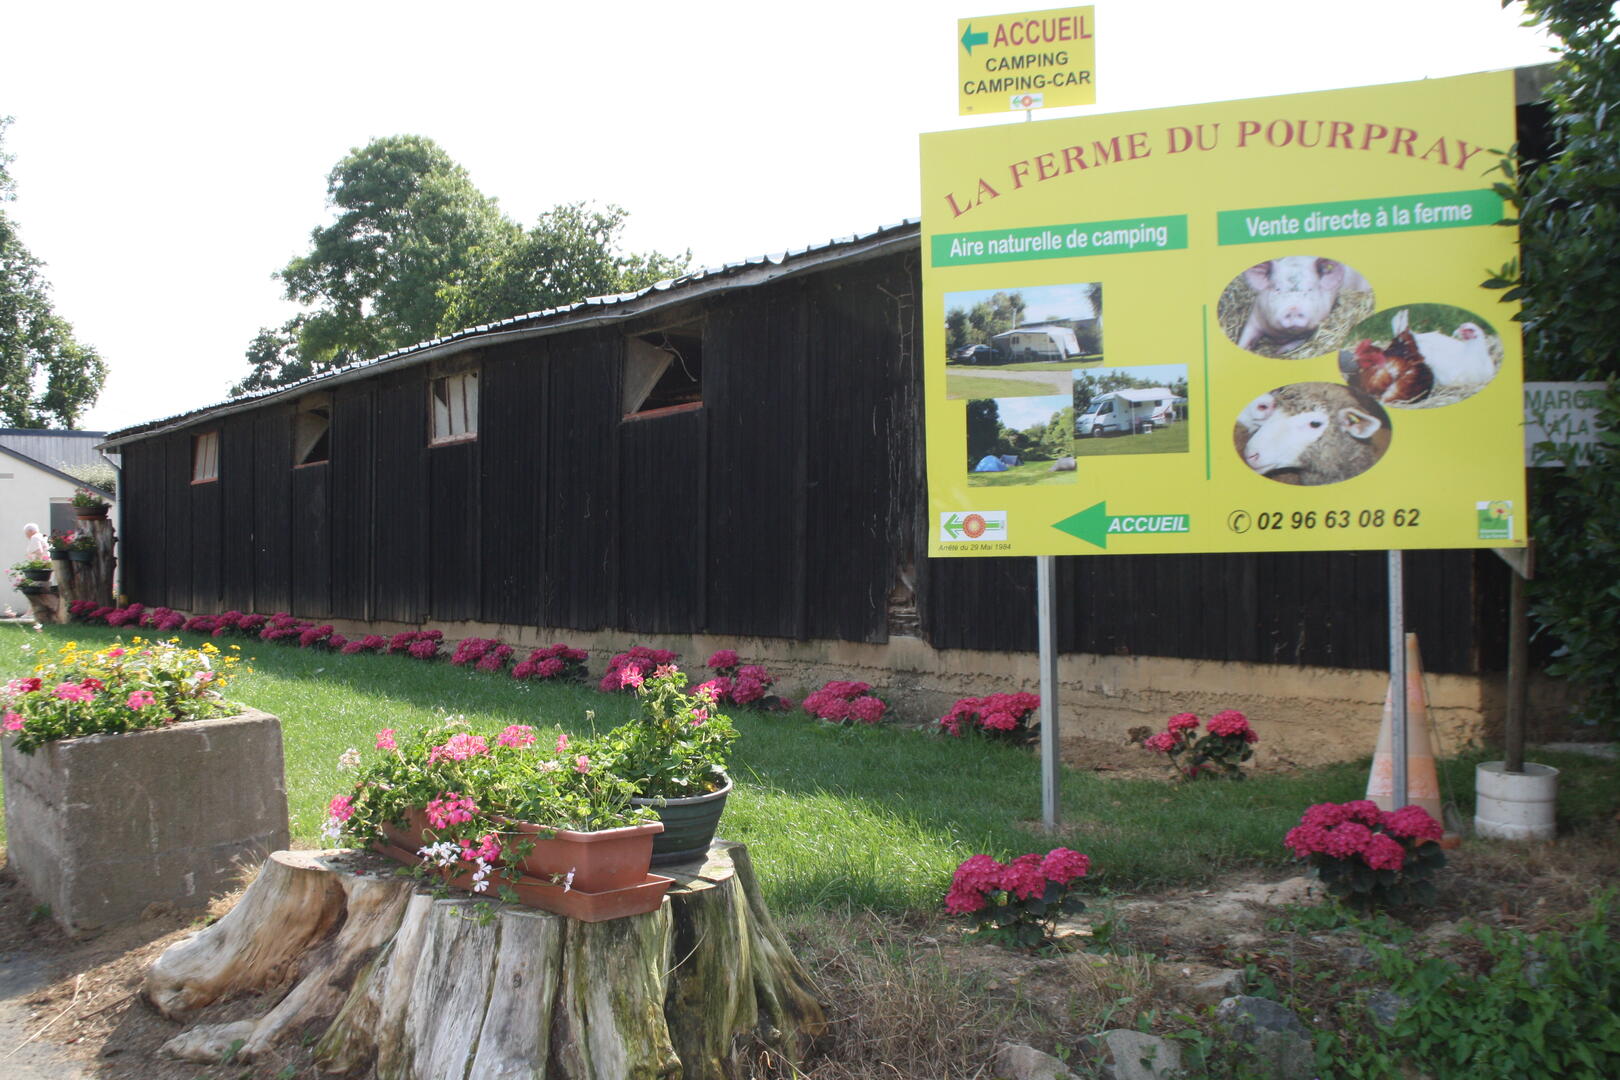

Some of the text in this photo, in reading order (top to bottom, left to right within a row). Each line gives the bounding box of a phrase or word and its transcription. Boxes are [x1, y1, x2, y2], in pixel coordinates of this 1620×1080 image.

[993, 15, 1092, 48] ACCUEIL
[985, 51, 1069, 72] CAMPING
[963, 70, 1091, 95] CAMPING-CAR
[944, 119, 1483, 218] LA FERME DU POURPRAY
[1246, 202, 1472, 237] Vente directe à la ferme
[949, 223, 1168, 257] Aire naturelle de camping
[1108, 516, 1189, 532] ACCUEIL
[1257, 508, 1420, 530] 02 96 63 08 62
